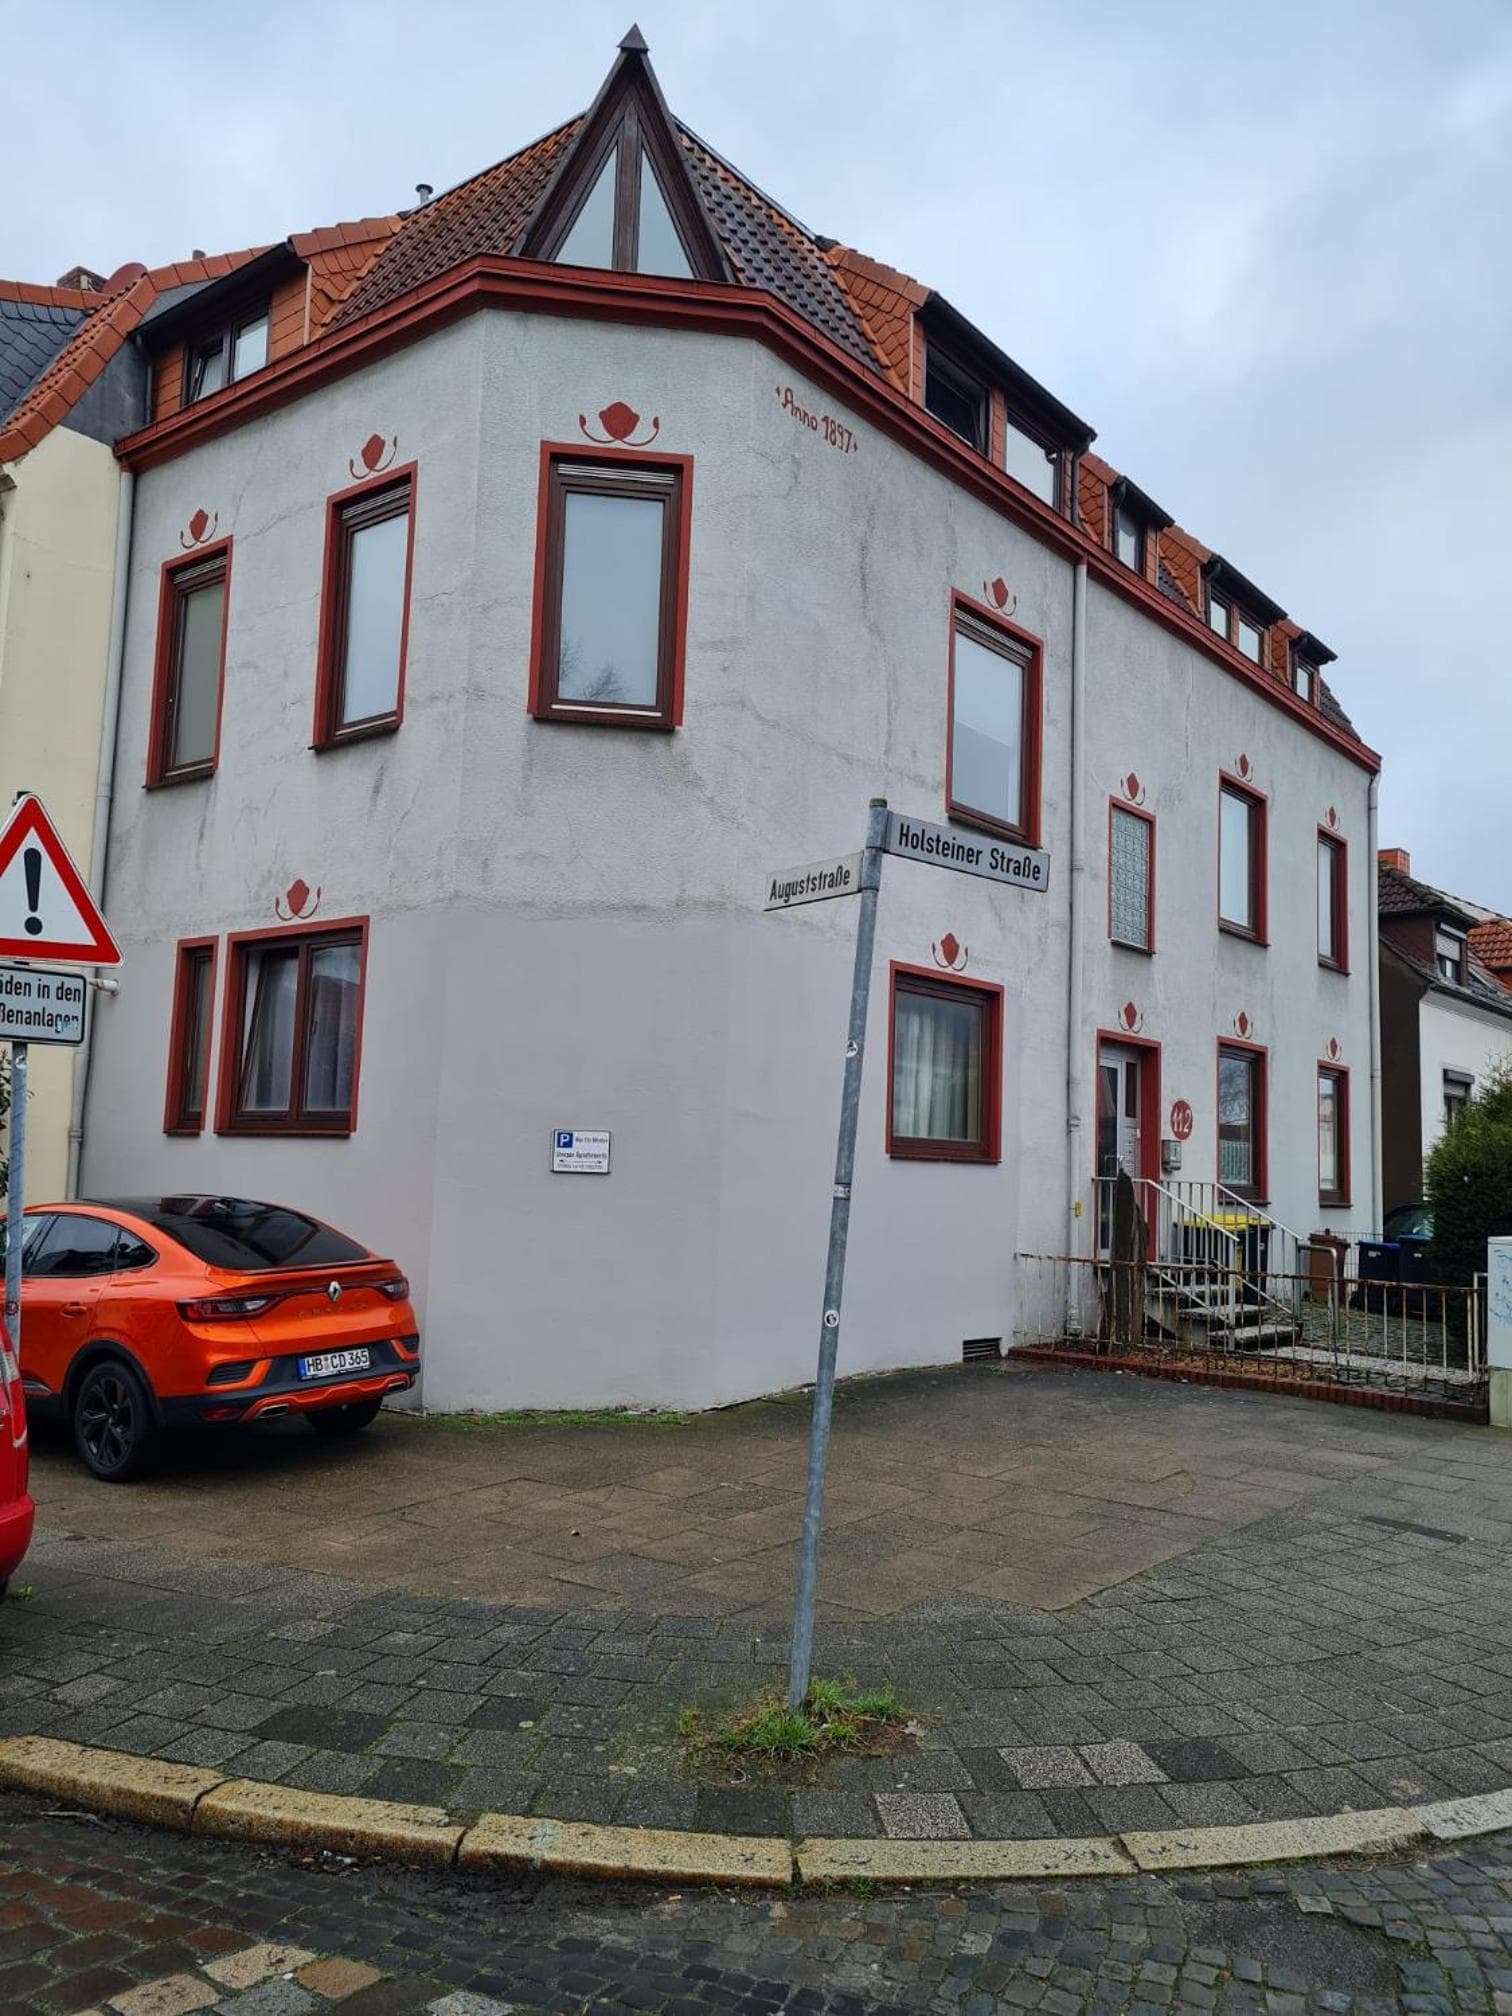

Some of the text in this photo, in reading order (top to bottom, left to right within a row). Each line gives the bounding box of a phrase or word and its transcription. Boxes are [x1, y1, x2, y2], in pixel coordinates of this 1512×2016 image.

[781, 387, 853, 453] Anno 1897
[898, 823, 1041, 881] Holsteiner Straße
[769, 865, 851, 904] Auguststraße
[37, 978, 50, 999] in
[56, 980, 81, 1002] den
[306, 1350, 368, 1373] HB CD 365
